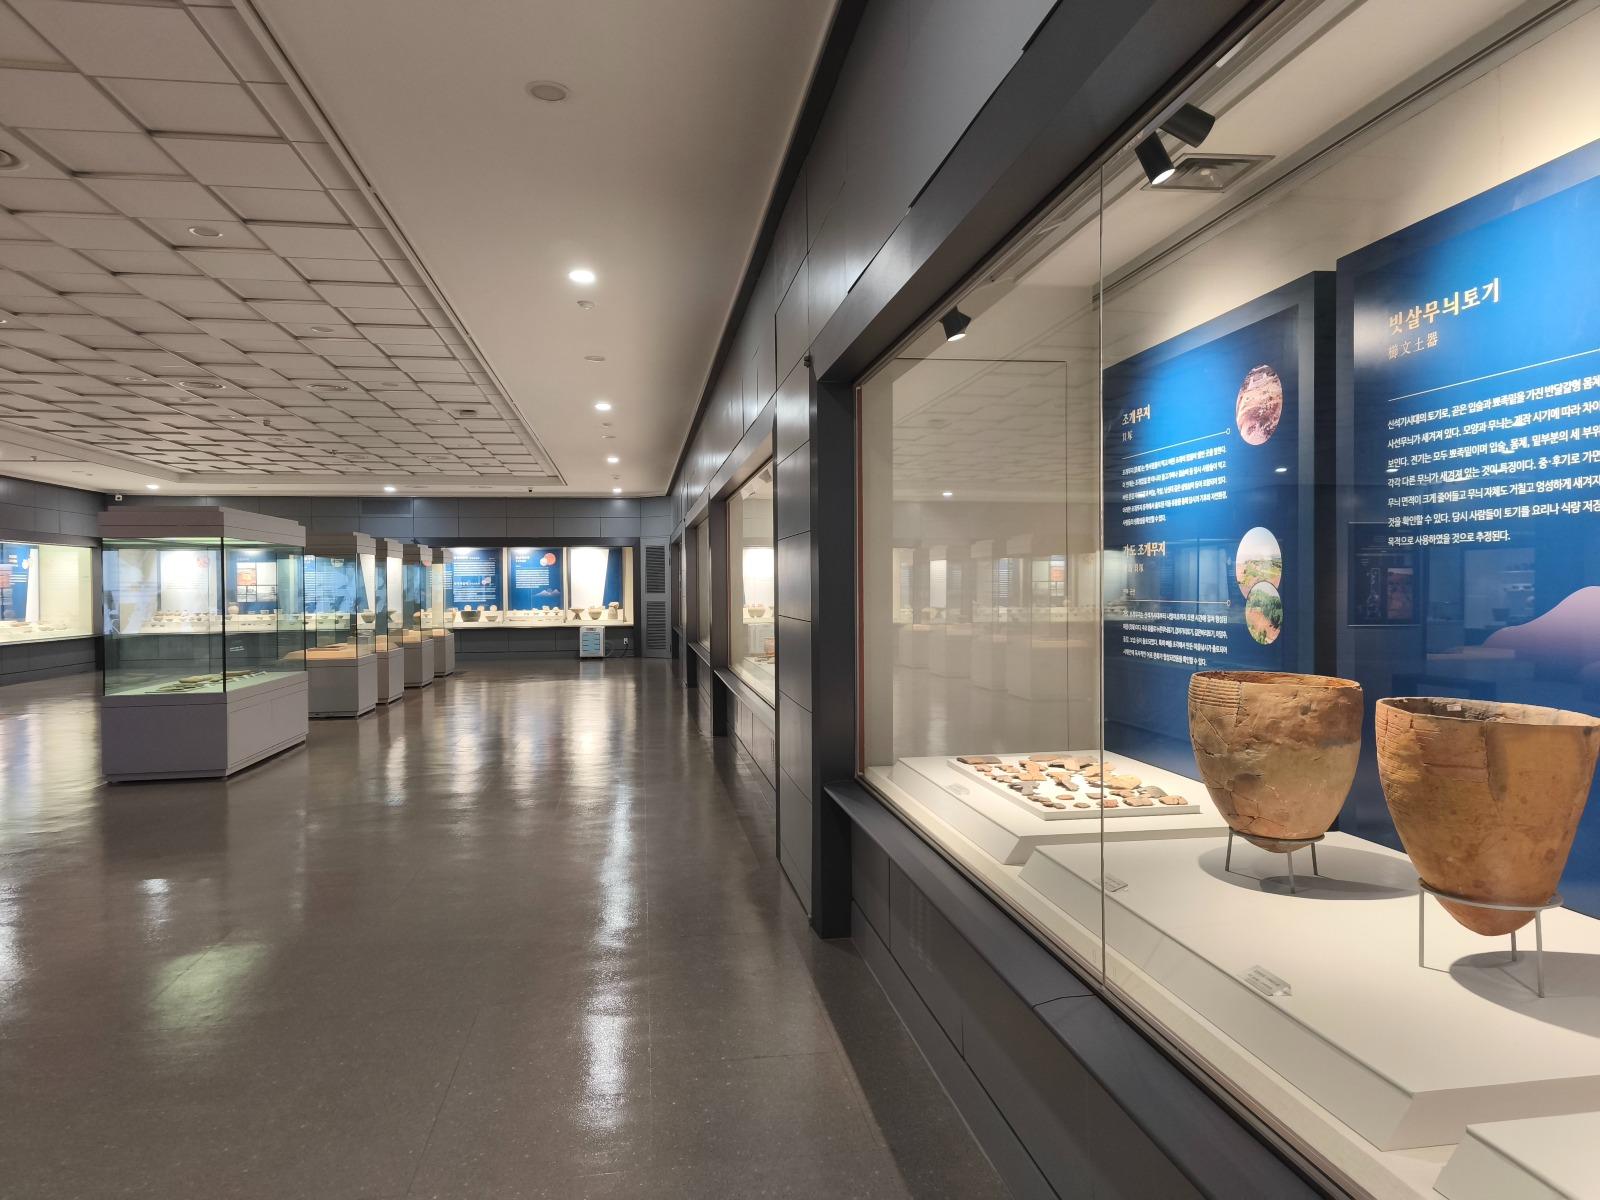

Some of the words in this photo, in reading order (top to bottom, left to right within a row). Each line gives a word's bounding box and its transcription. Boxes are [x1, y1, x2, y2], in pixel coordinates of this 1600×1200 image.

[1389, 277, 1498, 335] 빗살무늬토기
[1122, 404, 1150, 425] 조개무지
[1388, 413, 1427, 430] 신석기시대의
[1452, 404, 1467, 416] 곧은
[1468, 399, 1491, 413] 입술과
[1526, 387, 1544, 400] 가진
[1388, 434, 1421, 449] 사선무늬가
[1444, 427, 1462, 439] 있다.
[1464, 422, 1486, 435] 모양과
[1488, 418, 1513, 431] 무늬는
[1533, 407, 1560, 422] 시기에
[1562, 404, 1581, 417] 따라
[1388, 458, 1409, 469] 보인다.
[1410, 454, 1432, 466] 전기는
[1433, 450, 1447, 461] 모두
[1510, 437, 1530, 450] 몸체,
[1570, 428, 1580, 439] 세
[1388, 478, 1400, 487] 각각
[1402, 476, 1415, 486] 다른
[1417, 472, 1439, 484] 무늬가
[1465, 467, 1480, 479] 있는
[1388, 497, 1400, 507] 무늬
[1401, 496, 1421, 506] 면적이
[1423, 493, 1436, 503] 크게
[1468, 488, 1483, 499] 무늬
[1484, 484, 1508, 497] 자체도
[1510, 482, 1534, 495] 거칠고
[1536, 478, 1571, 493] 엉성하게
[1388, 516, 1401, 527] 것을
[1402, 515, 1423, 526] 확인할
[1424, 516, 1432, 524] 수
[1434, 513, 1450, 523] 있다.
[1452, 511, 1468, 522] 당시
[1469, 508, 1502, 521] 사람들이
[1504, 506, 1530, 518] 토기를
[1532, 503, 1559, 515] 요리나
[1562, 501, 1581, 514] 식량
[1137, 540, 1166, 557] 조개무지
[1388, 535, 1414, 547] 목적으로
[1415, 533, 1450, 545] 사용하였을
[1452, 532, 1475, 543] 것으로
[1476, 530, 1510, 541] 추정된다.
